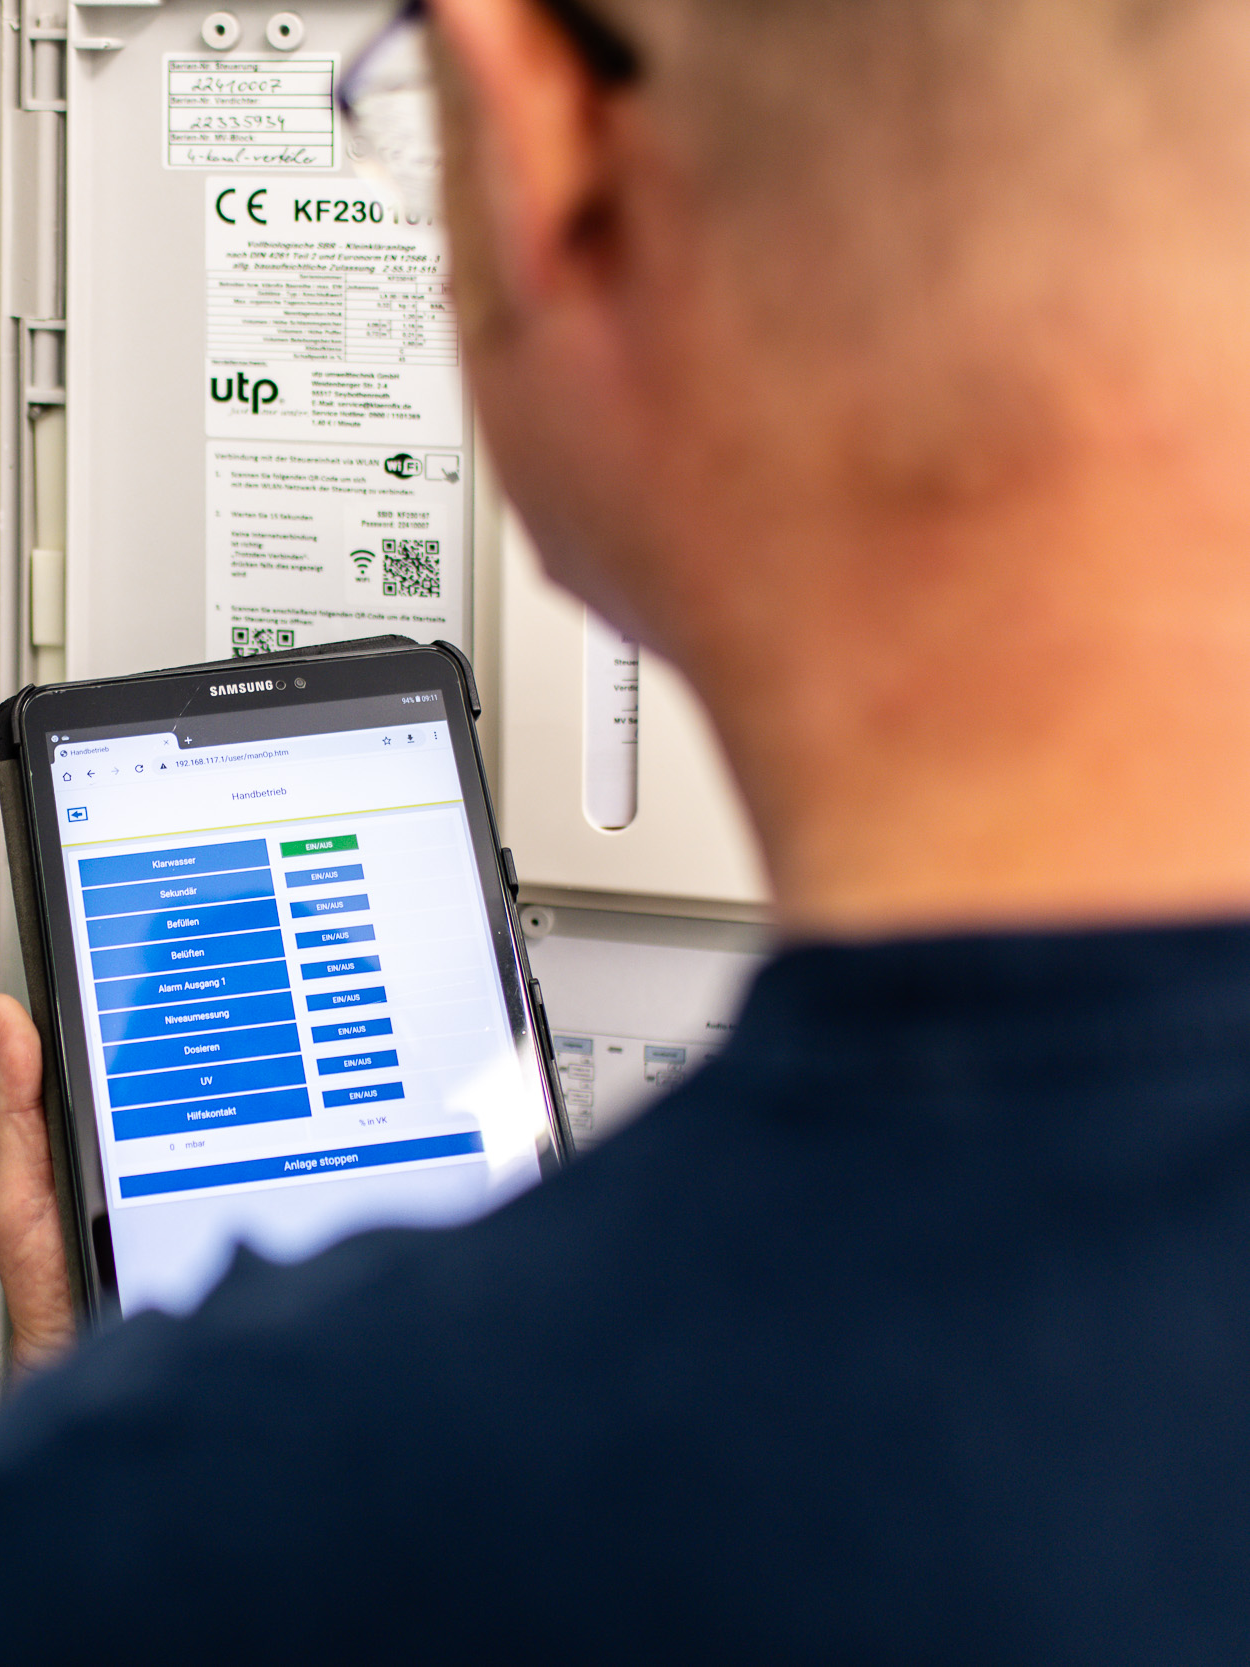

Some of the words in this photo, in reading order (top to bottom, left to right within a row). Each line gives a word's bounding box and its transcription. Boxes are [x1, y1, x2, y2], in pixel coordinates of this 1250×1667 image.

[210, 371, 279, 414] utp
[209, 680, 274, 697] SAMSUNG
[70, 744, 110, 757] Handbetrieb
[231, 786, 287, 801] Handbetrieb
[305, 840, 333, 850] EIN/AUS
[152, 856, 196, 869] Klarwasser
[311, 870, 339, 880] EIN/AUS
[160, 886, 198, 899] Sekundär
[316, 900, 343, 911] EIN/AUS
[166, 916, 200, 929] Befüllen
[321, 931, 349, 942] EIN/AUS
[171, 947, 205, 960] Belüften
[326, 962, 355, 972] EIN/AUS
[158, 980, 182, 993] Alarm
[184, 978, 219, 992] Ausgang
[332, 993, 360, 1004] EIN/AUS
[164, 1008, 230, 1025] Niveaumessung
[338, 1024, 366, 1035] EIN/AUS
[183, 1042, 220, 1056] Dosieren
[343, 1056, 372, 1067] EIN/AUS
[200, 1075, 213, 1086] UV
[349, 1089, 377, 1099] EIN/AUS
[187, 1106, 237, 1121] Hilfskontakt
[367, 1117, 374, 1126] in
[375, 1116, 388, 1126] VK
[185, 1139, 206, 1150] mbar
[284, 1156, 317, 1172] Anlage
[319, 1152, 359, 1168] stoppen
